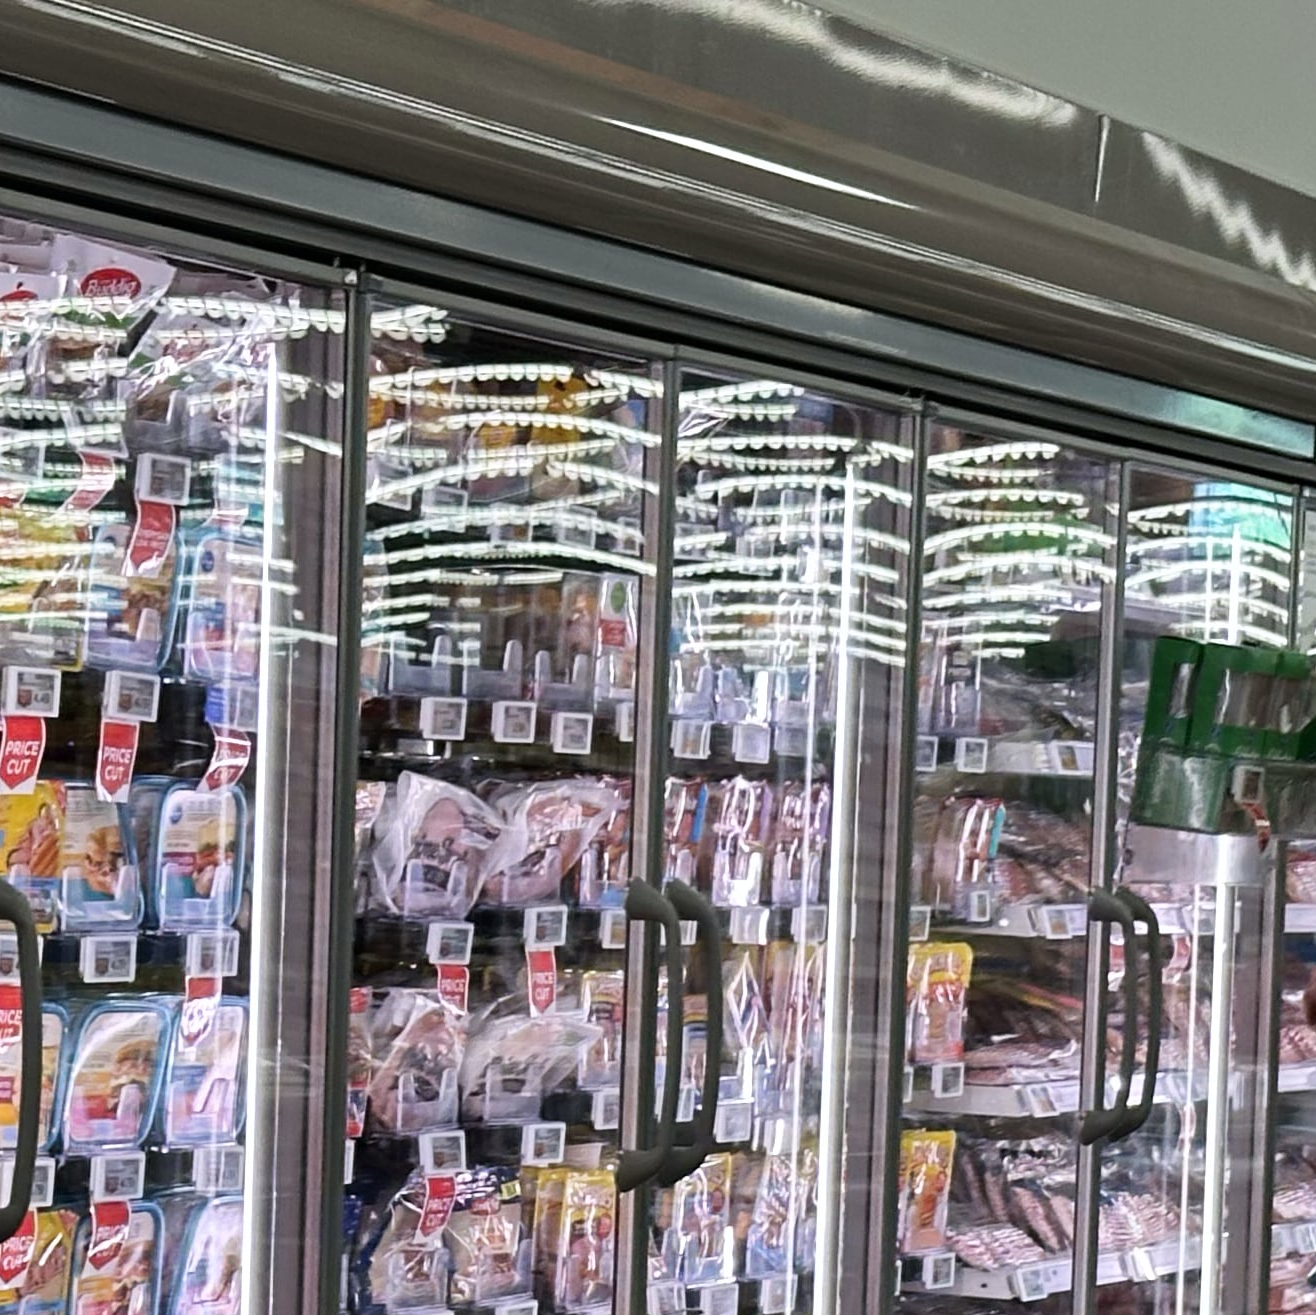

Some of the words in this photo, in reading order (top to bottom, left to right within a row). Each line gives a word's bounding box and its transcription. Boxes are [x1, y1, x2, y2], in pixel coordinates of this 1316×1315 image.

[5, 741, 40, 756] PRICE
[102, 747, 132, 764] PRICE
[6, 759, 30, 775] CUT
[104, 765, 125, 780] CUT
